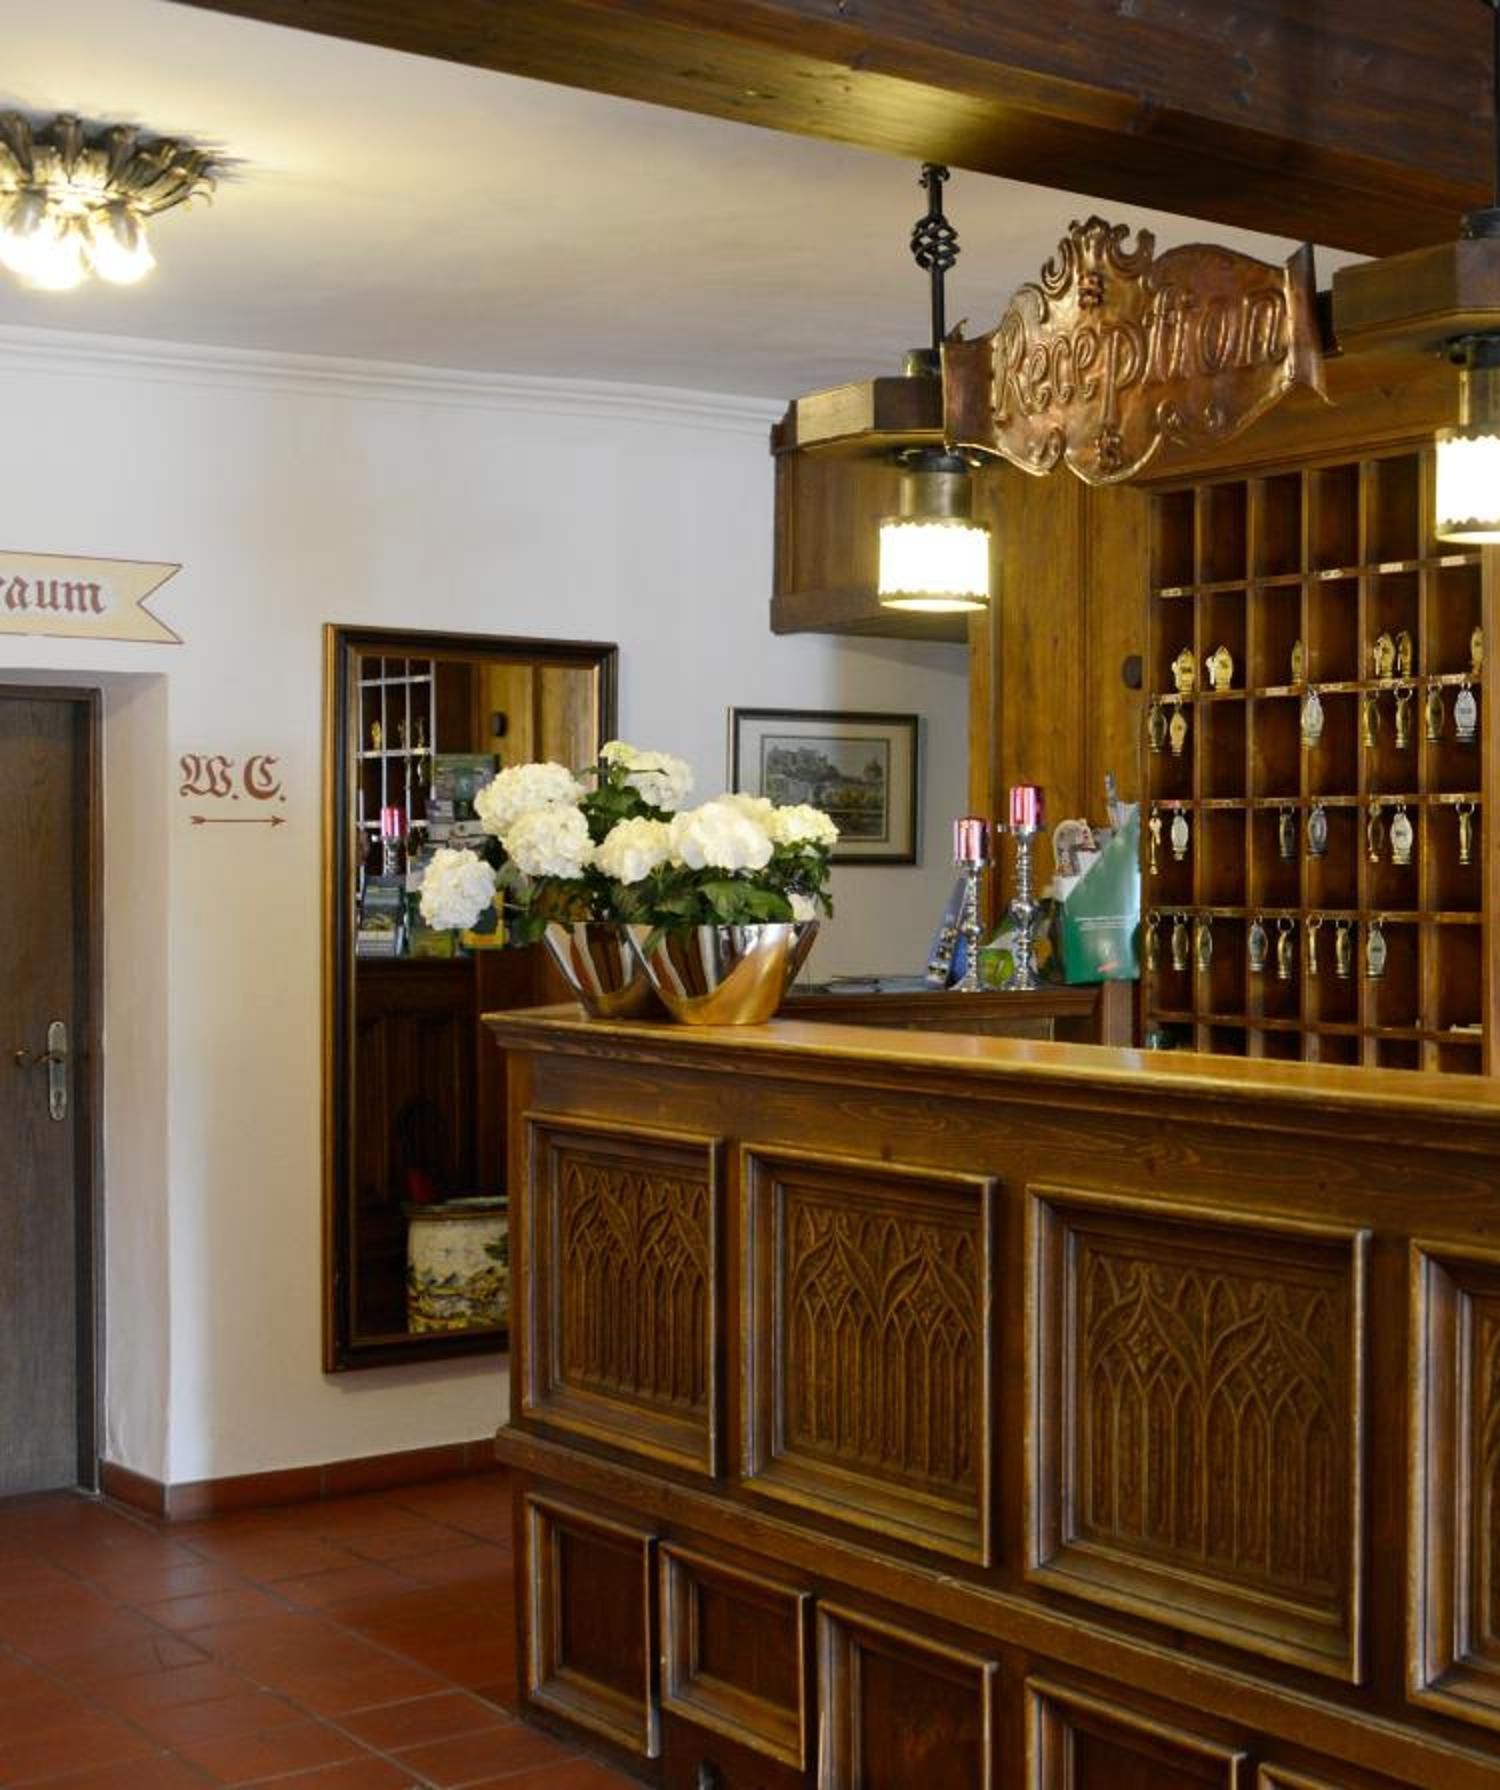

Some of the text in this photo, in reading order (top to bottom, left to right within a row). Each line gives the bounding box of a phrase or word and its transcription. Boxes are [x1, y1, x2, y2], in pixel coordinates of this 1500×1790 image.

[992, 284, 1288, 428] Reception
[0, 576, 106, 614] aum
[179, 753, 286, 802] W.C.
